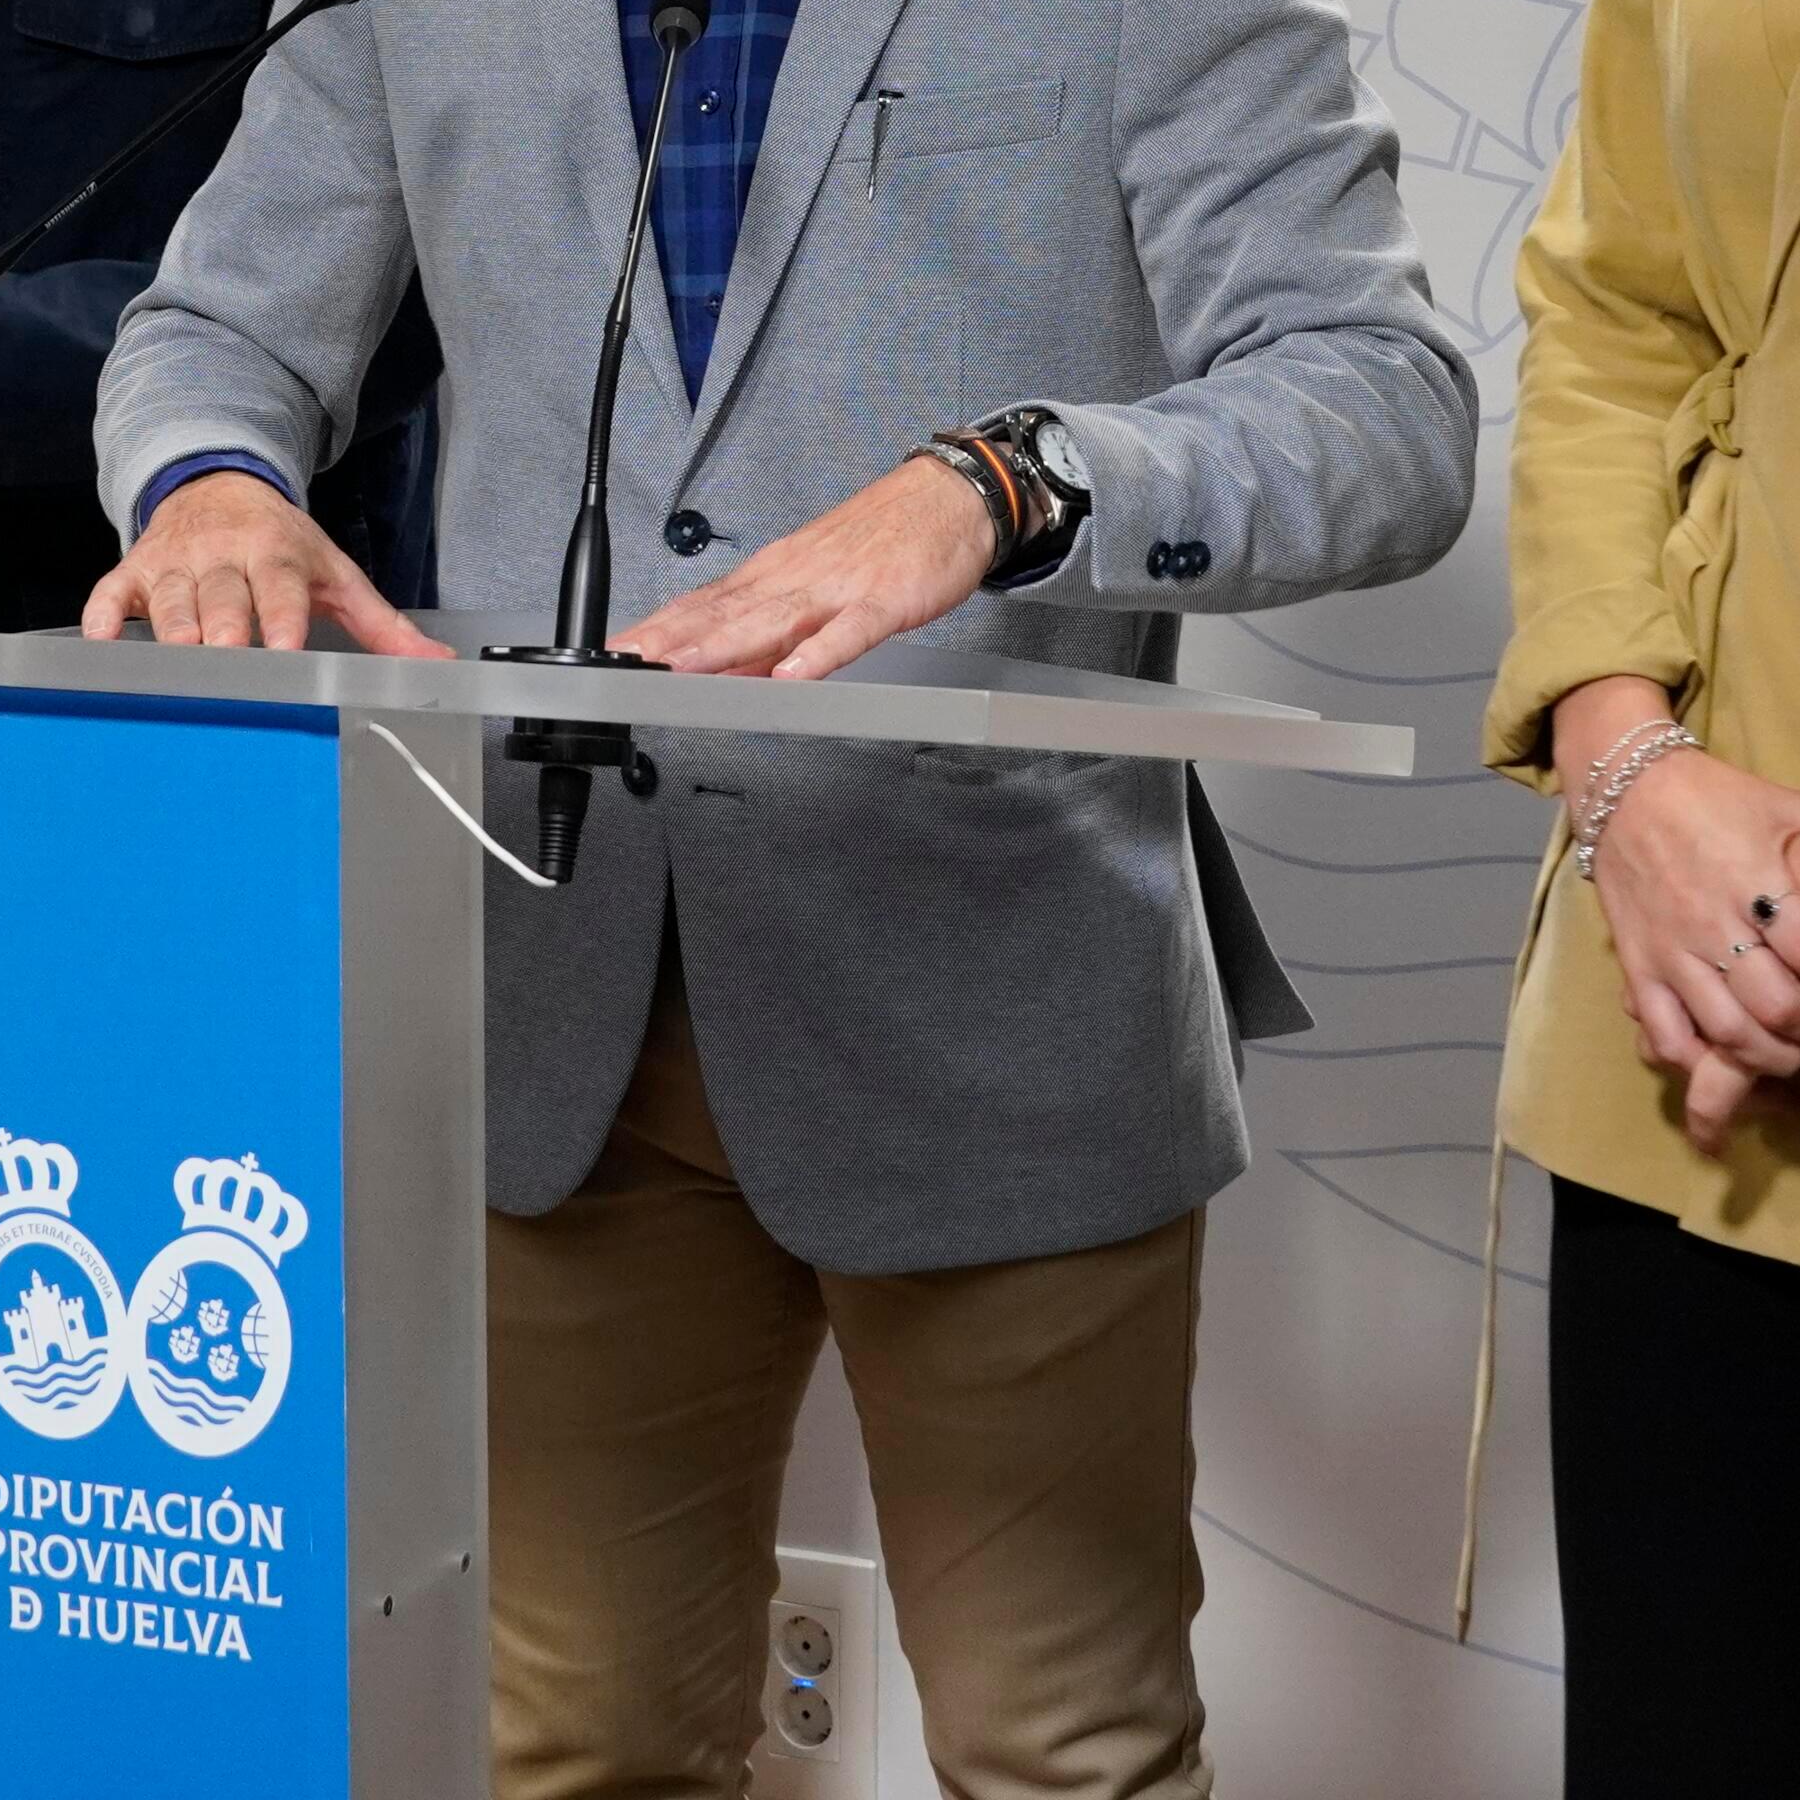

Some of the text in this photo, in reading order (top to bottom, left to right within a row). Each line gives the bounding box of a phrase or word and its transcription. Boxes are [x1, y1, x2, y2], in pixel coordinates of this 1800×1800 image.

[11, 1225, 25, 1239] ET
[27, 1223, 73, 1246] TERRAE
[58, 1593, 251, 1661] HUELVA
